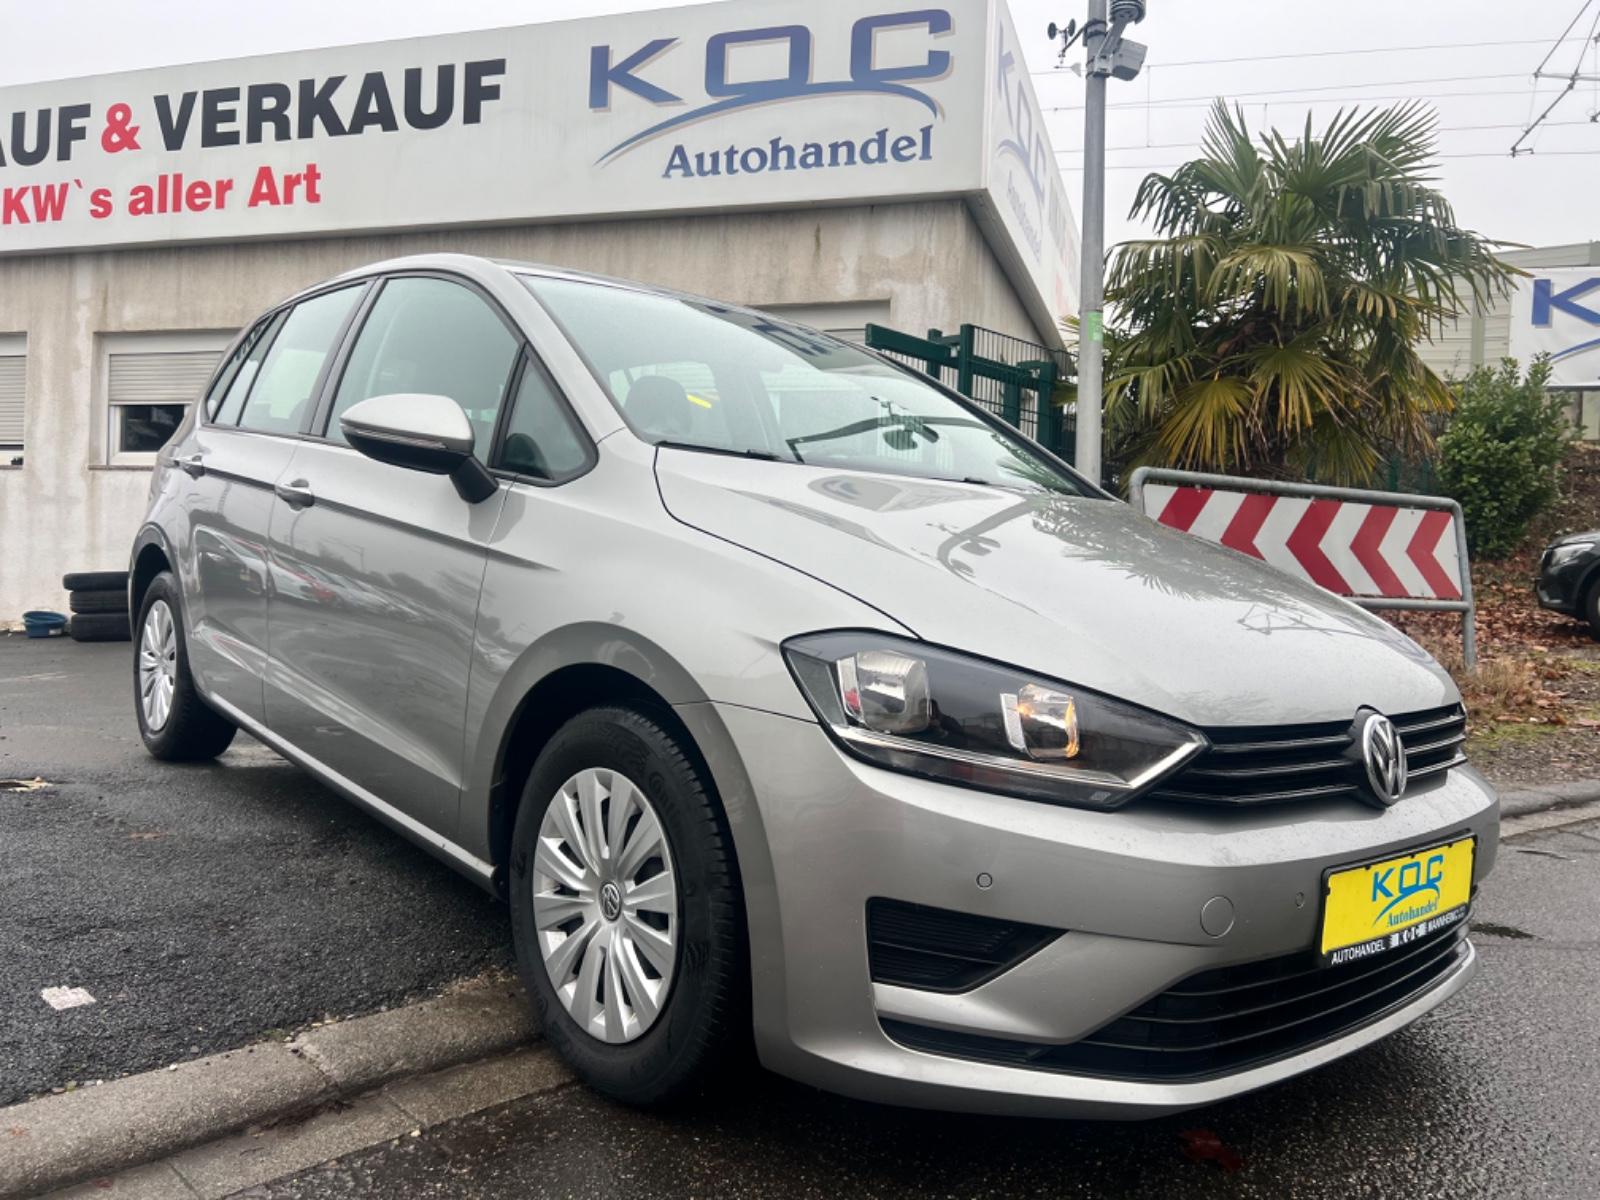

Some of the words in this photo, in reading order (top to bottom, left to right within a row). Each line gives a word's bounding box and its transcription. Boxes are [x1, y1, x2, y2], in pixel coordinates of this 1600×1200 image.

[101, 102, 141, 154] &
[154, 58, 506, 152] VERKAUF
[662, 123, 934, 179] Autohandel
[128, 173, 233, 216] aller
[247, 163, 321, 208] Art
[1387, 897, 1438, 928] Autohandel
[1331, 939, 1386, 965] AUTOHANDEL
